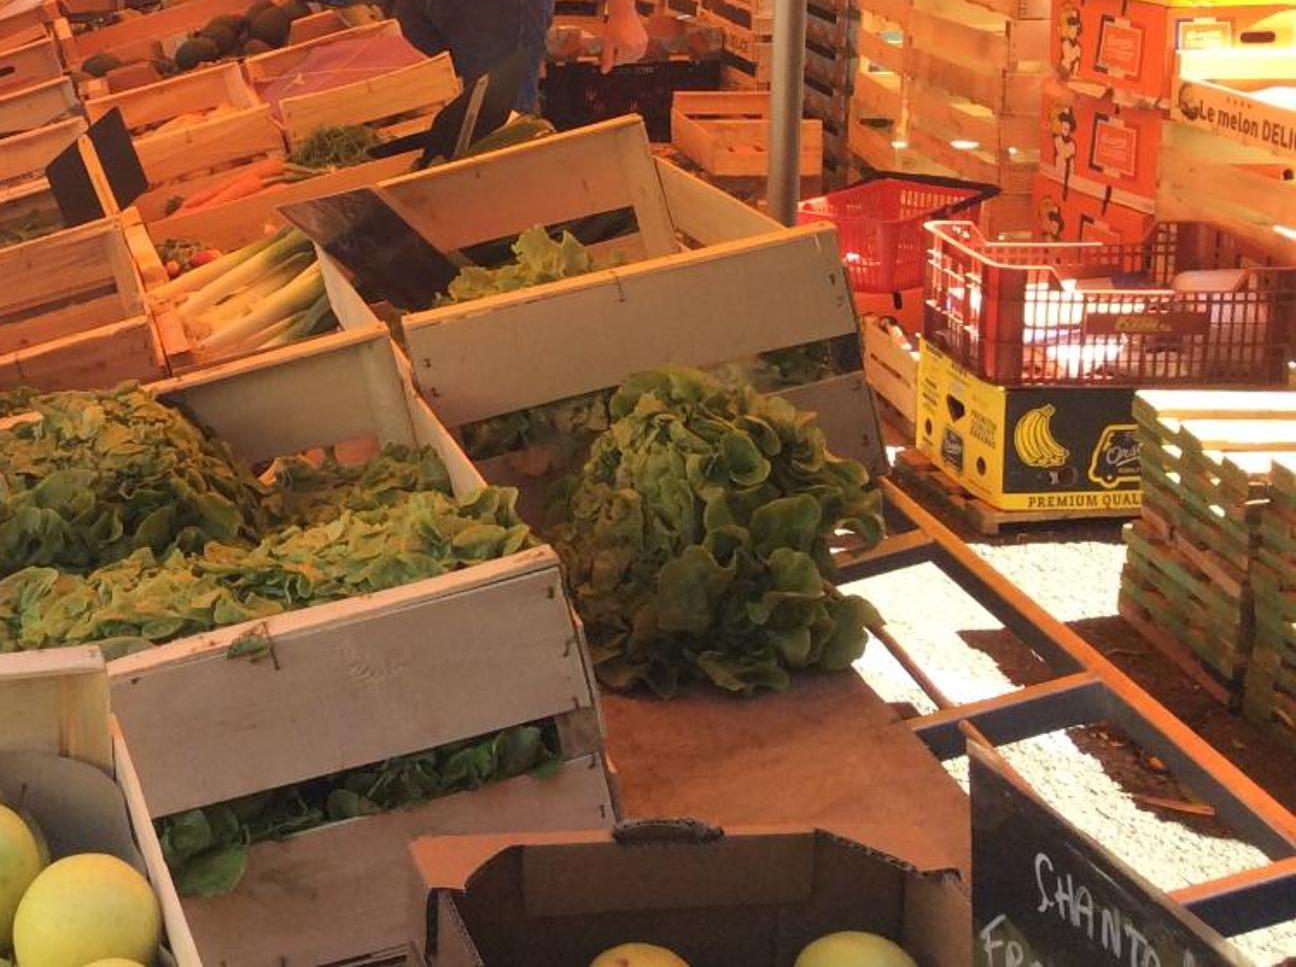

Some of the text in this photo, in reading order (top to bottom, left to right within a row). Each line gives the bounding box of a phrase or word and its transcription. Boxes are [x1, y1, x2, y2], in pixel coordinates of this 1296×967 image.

[1199, 99, 1296, 152] Le melon DELI
[1027, 492, 1141, 509] PREMIUM QUAL
